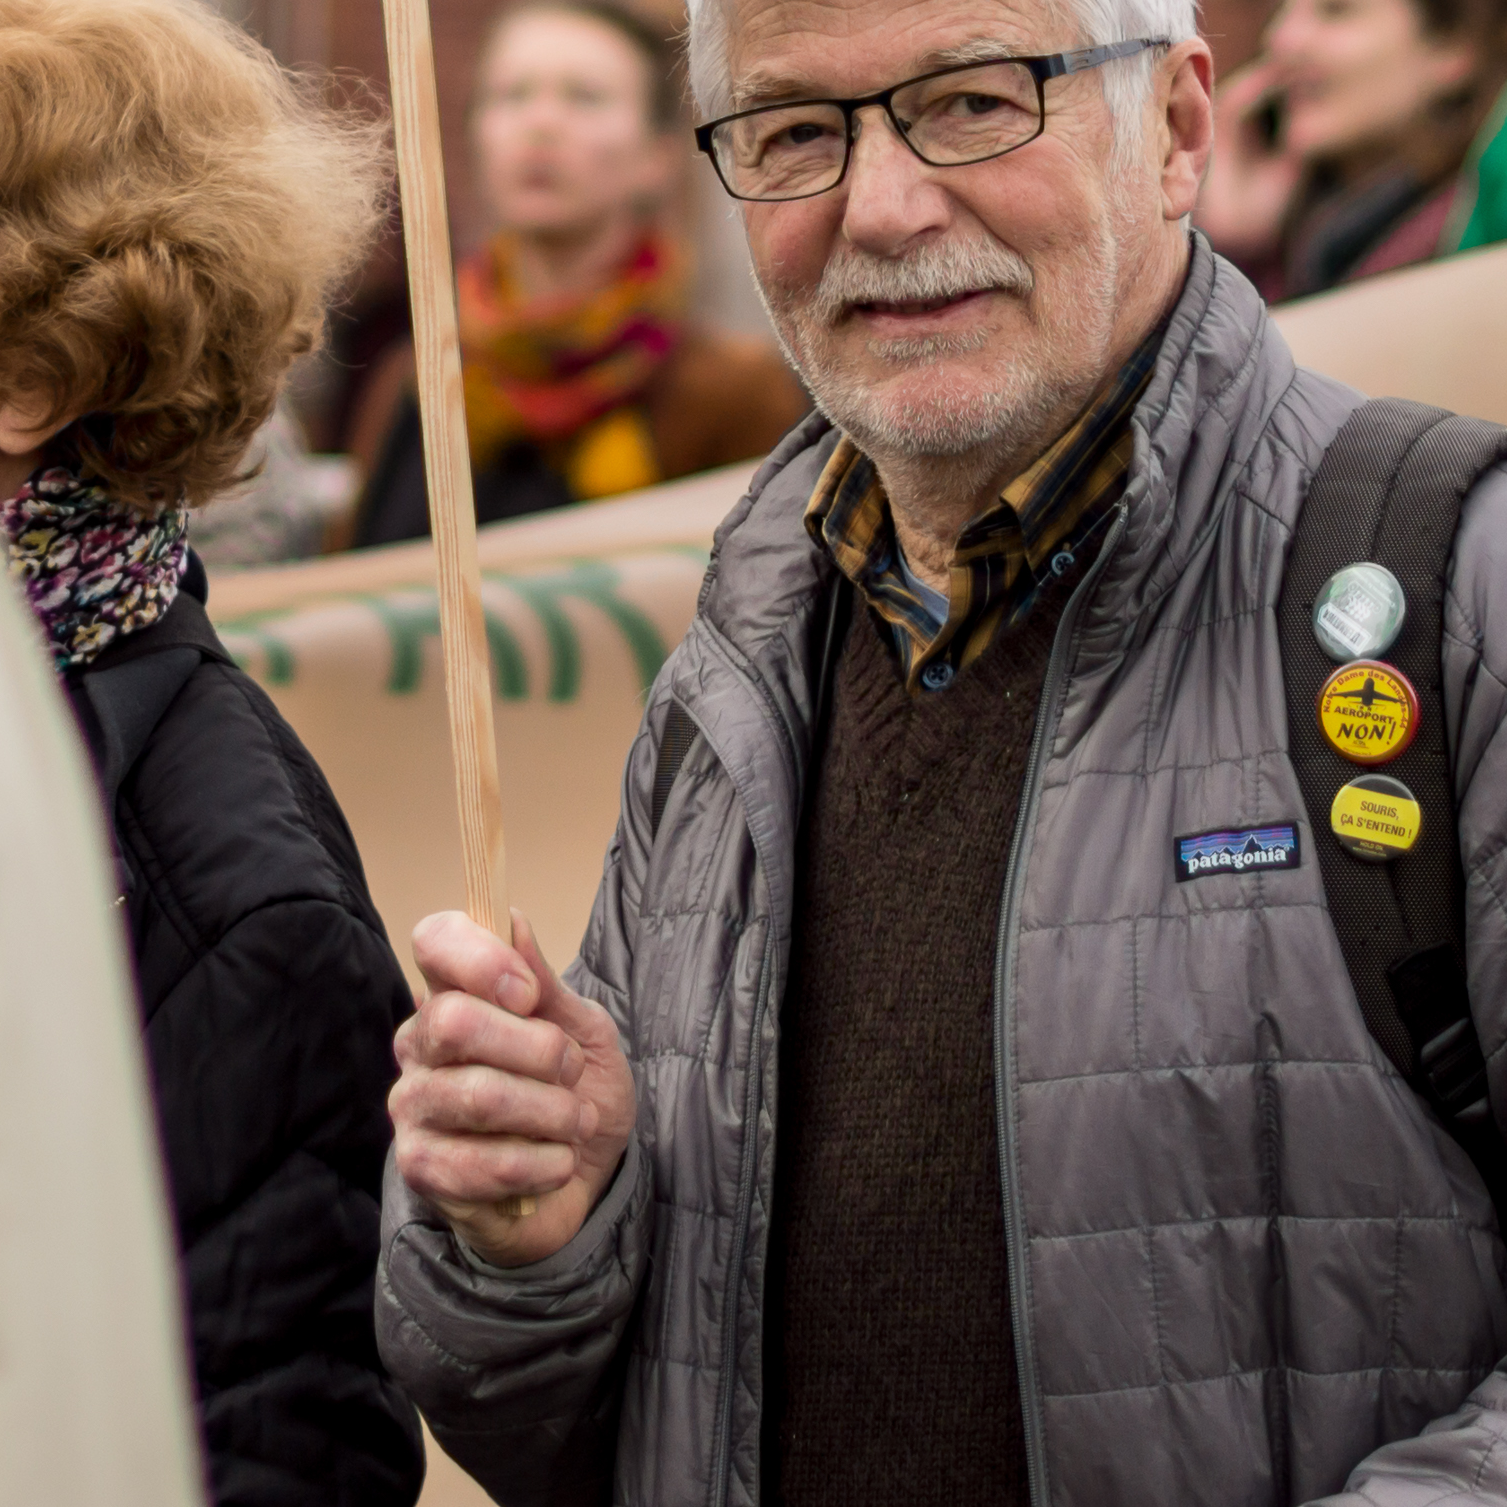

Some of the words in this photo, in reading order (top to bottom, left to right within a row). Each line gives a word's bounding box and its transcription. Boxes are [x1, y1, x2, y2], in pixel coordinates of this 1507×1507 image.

[1337, 670, 1365, 686] Dame
[1367, 670, 1385, 681] des
[1360, 800, 1400, 821] SOURIS,
[1340, 813, 1354, 826] ÇA
[1356, 816, 1406, 838] S'ENTEND
[1188, 847, 1287, 874] patagonia
